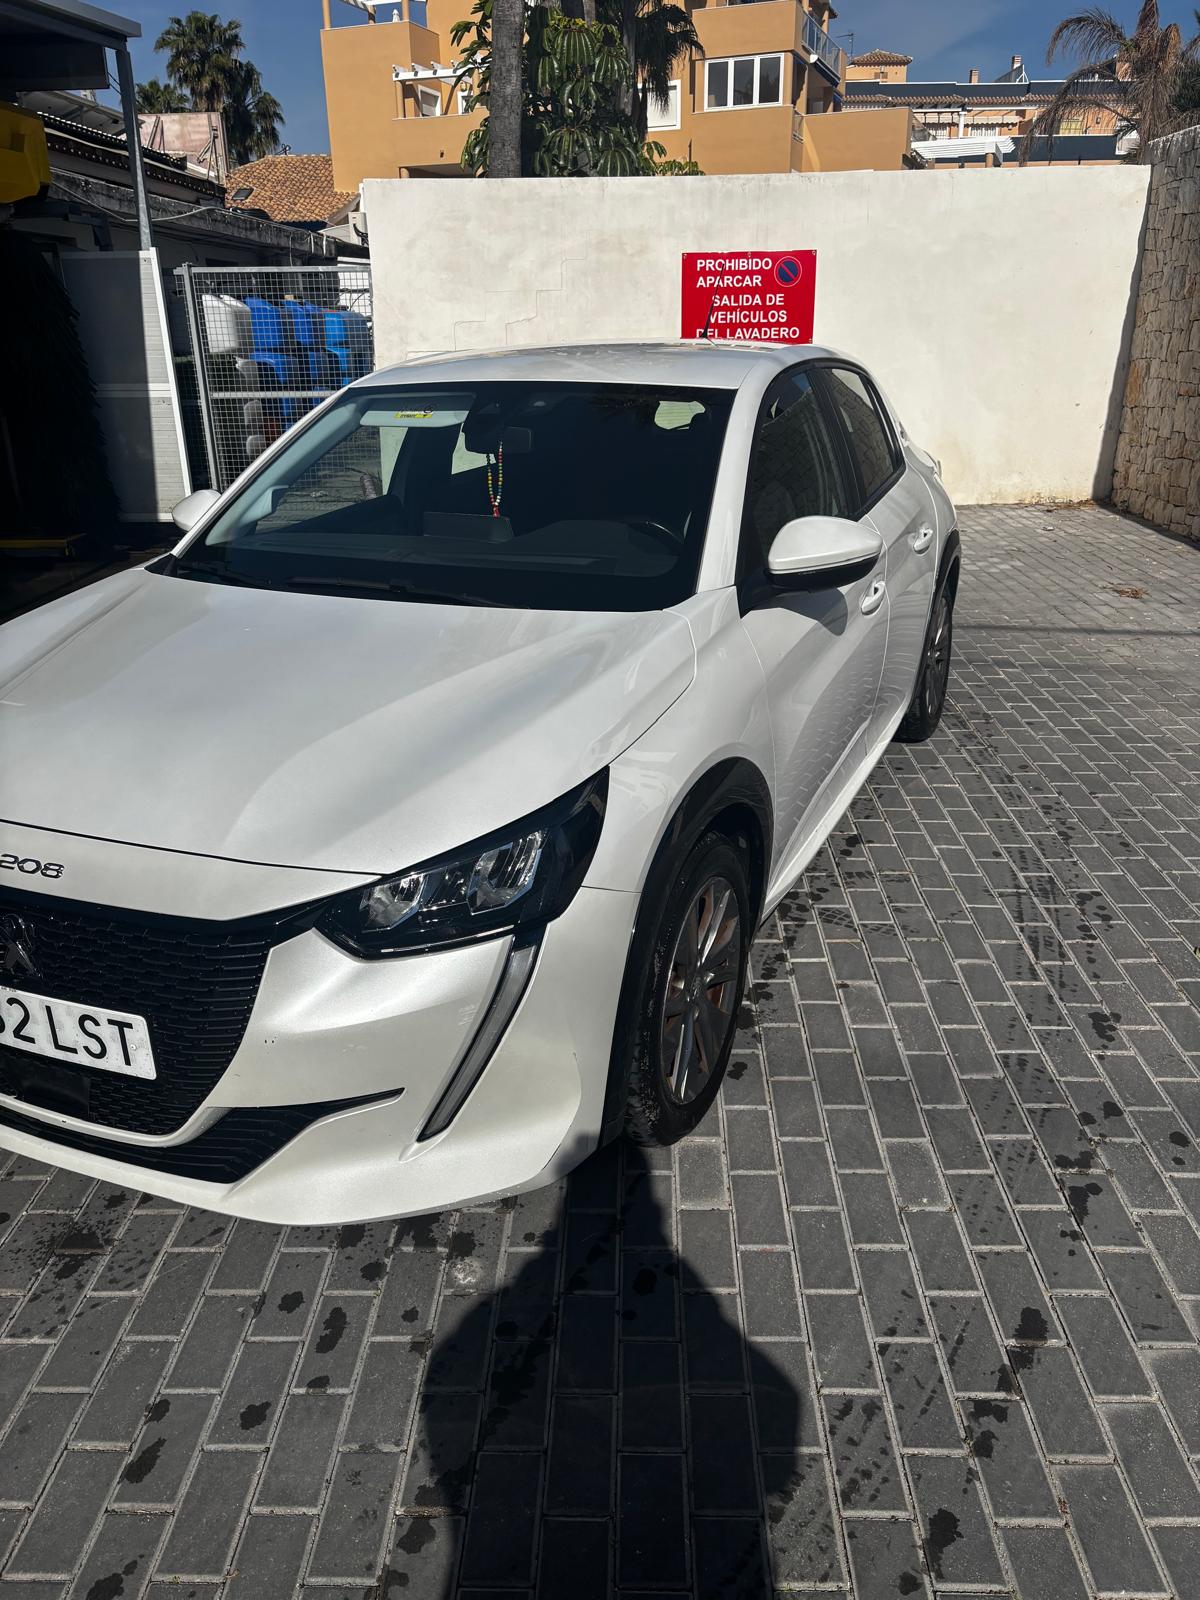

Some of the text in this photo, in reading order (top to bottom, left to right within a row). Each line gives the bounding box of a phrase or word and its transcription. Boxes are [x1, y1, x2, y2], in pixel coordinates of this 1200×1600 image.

[697, 258, 773, 271] PROHIBIDO
[696, 275, 762, 288] APARCAR
[712, 293, 785, 307] SALIDA DE
[709, 308, 788, 324] VEHÍCULOS
[726, 326, 800, 339] LAVADERO
[0, 853, 65, 879] 208
[0, 997, 134, 1067] 2 LST
